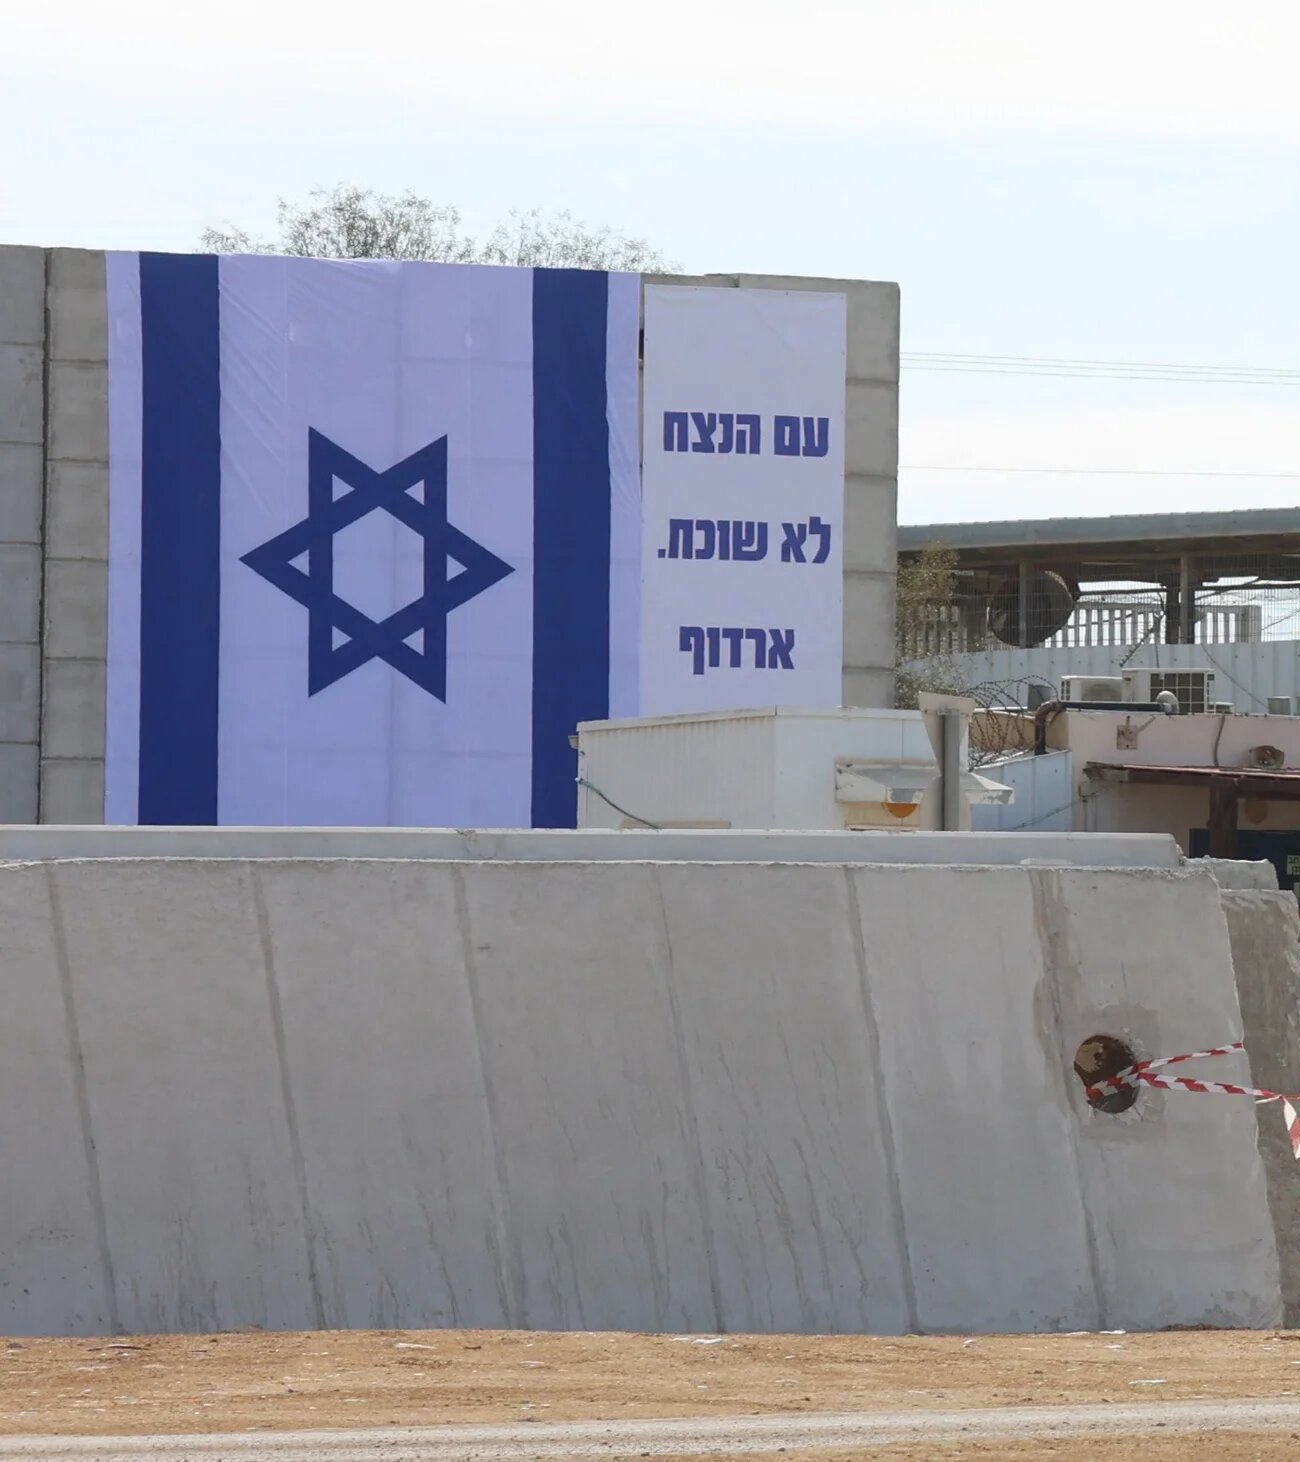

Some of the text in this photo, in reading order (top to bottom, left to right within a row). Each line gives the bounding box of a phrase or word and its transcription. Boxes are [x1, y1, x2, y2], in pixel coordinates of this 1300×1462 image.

[663, 411, 829, 457] עם הנצח
[657, 516, 831, 564] לא שוכח.
[679, 626, 795, 675] ארדוף
